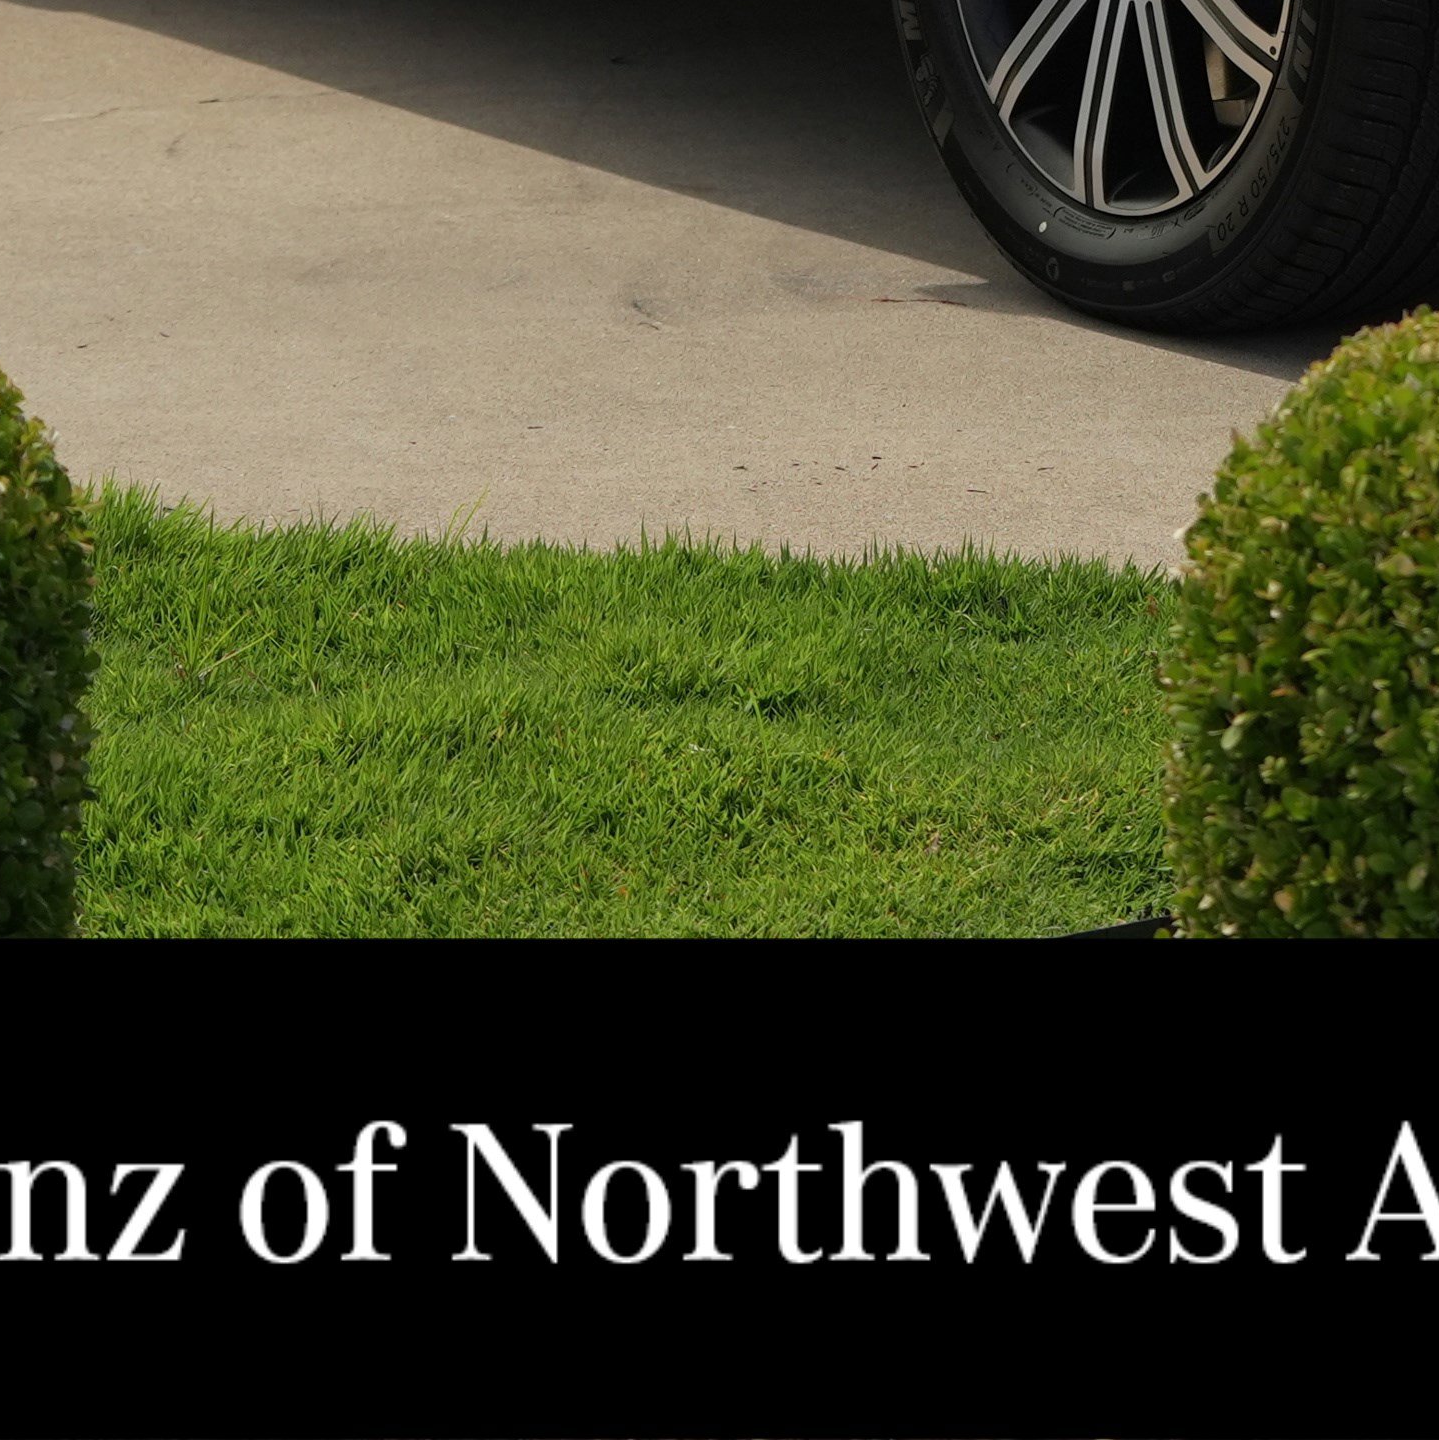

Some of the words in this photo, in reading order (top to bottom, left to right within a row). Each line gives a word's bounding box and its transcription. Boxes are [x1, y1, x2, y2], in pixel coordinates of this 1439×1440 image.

[1250, 116, 1291, 199] 275/50
[1238, 194, 1250, 218] R
[1217, 211, 1236, 242] 20
